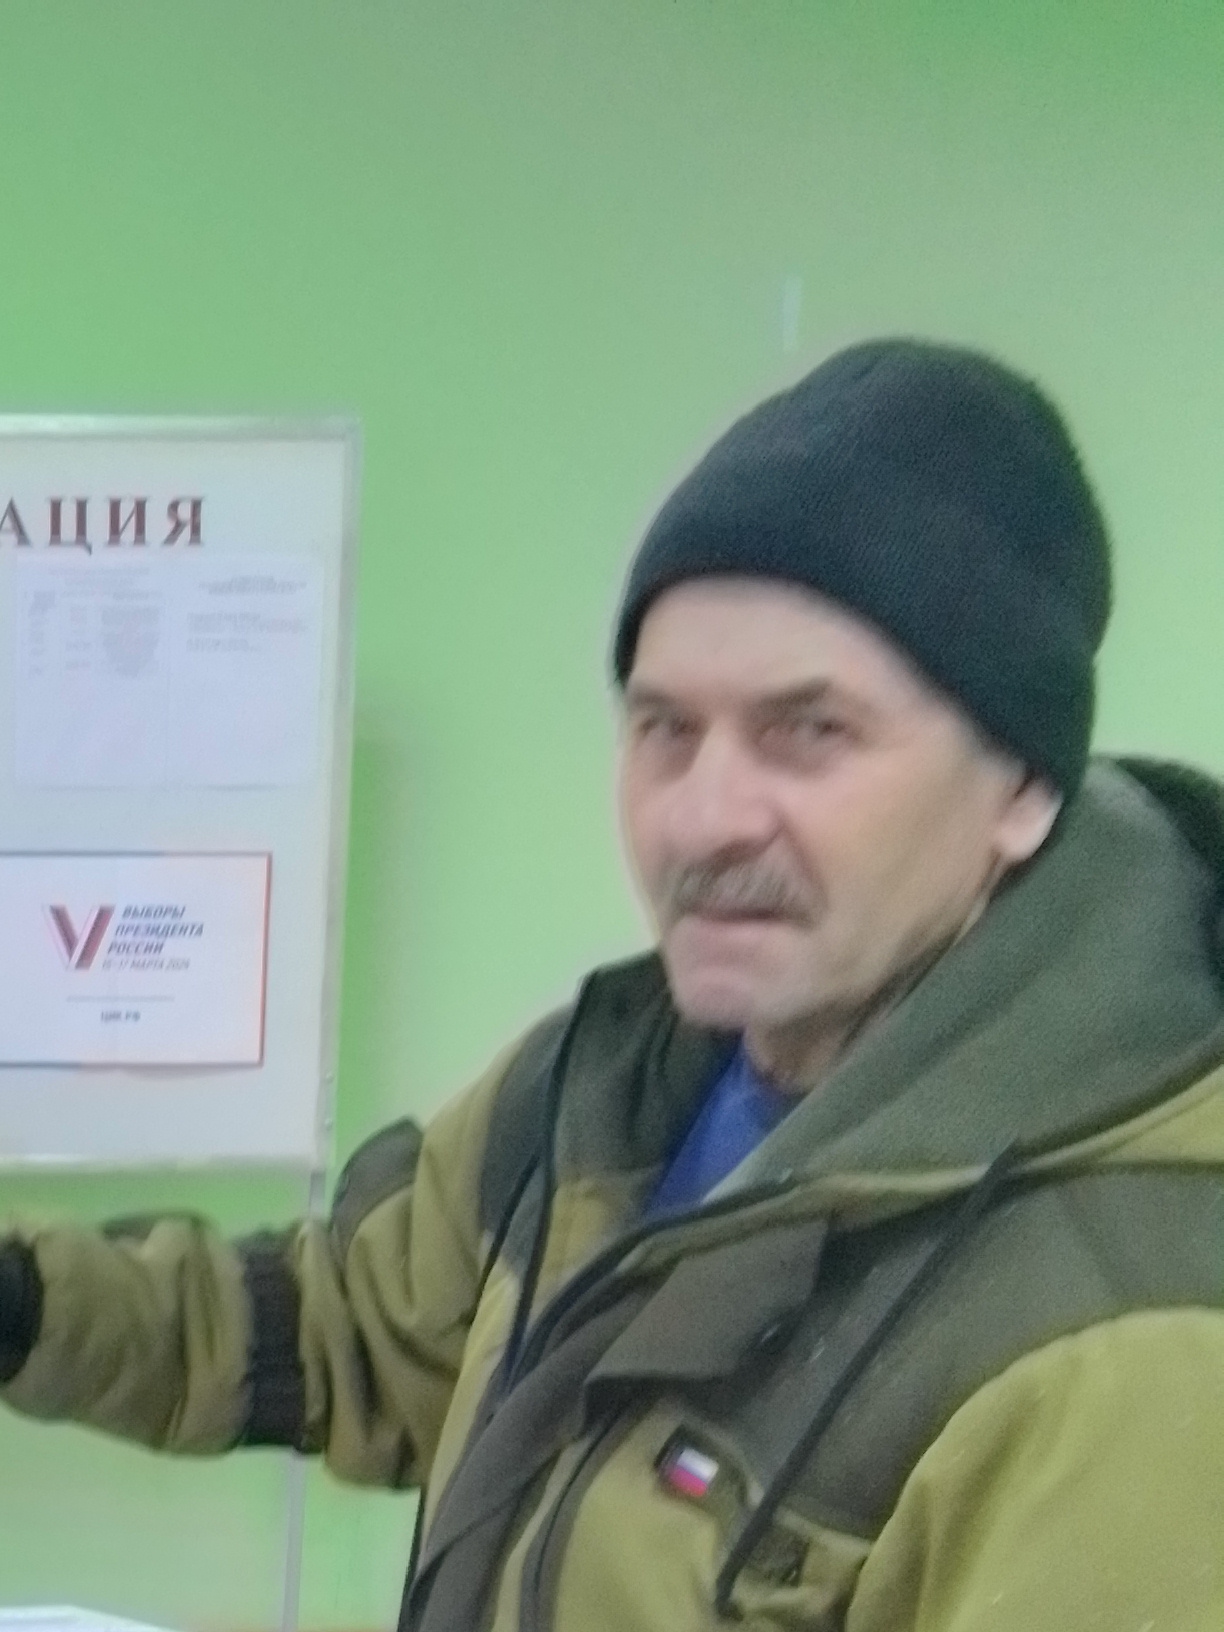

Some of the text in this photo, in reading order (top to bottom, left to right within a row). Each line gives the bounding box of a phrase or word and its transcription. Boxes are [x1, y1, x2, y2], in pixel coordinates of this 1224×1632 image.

[122, 905, 186, 919] ВЫБОРЫ
[115, 923, 204, 938] ПРЕЗИДЕНТА
[107, 941, 165, 955] РОССИИ
